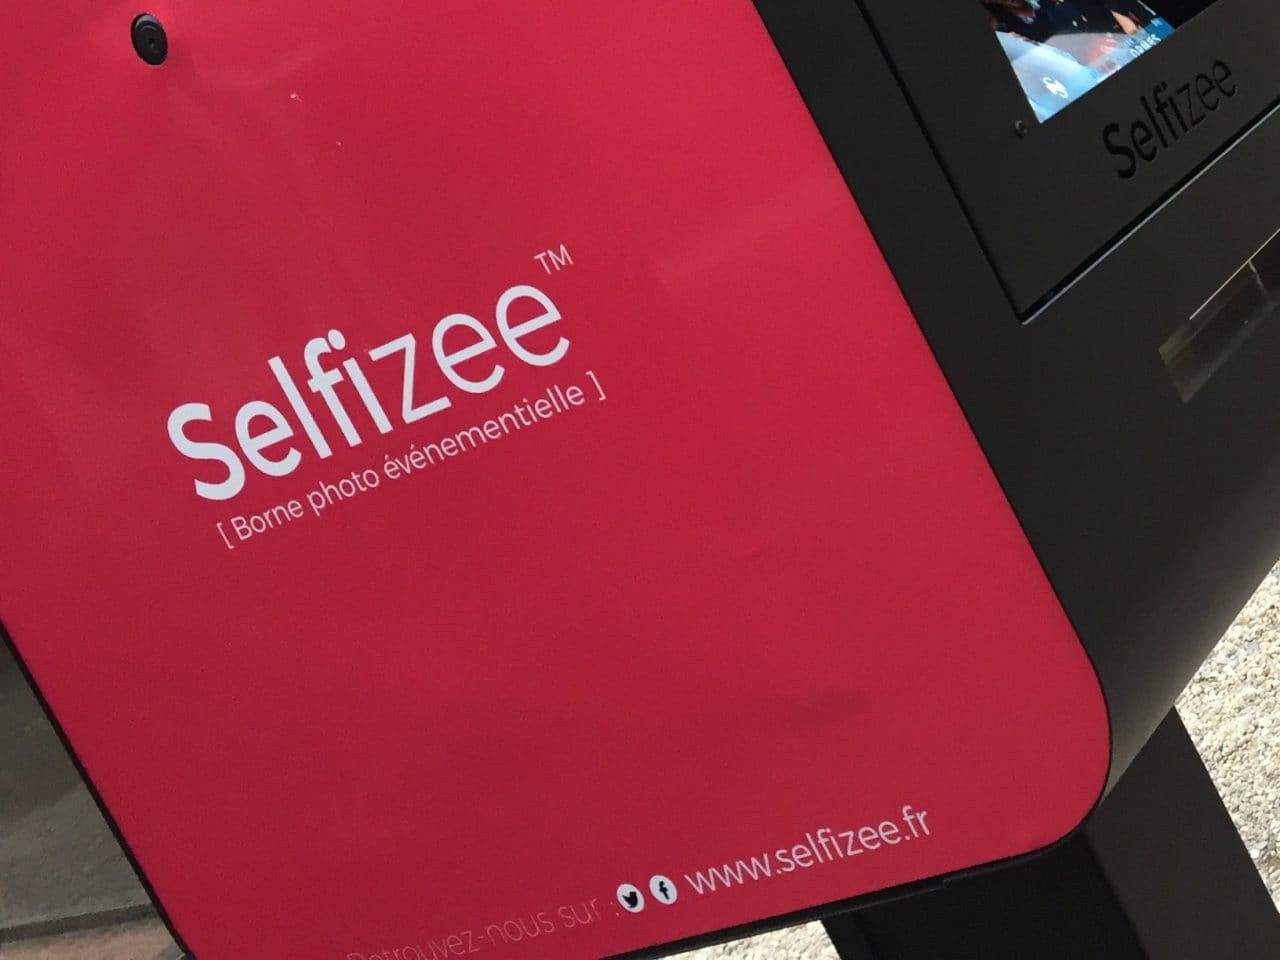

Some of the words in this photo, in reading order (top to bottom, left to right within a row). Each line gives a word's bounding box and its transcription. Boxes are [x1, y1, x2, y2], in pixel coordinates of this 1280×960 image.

[1103, 60, 1238, 179] Selfizee
[166, 283, 571, 501] Selfizee
[306, 467, 380, 517] photo
[383, 382, 585, 481] événementielle
[684, 805, 931, 895] www.selfizee.fr
[557, 897, 600, 928] sur
